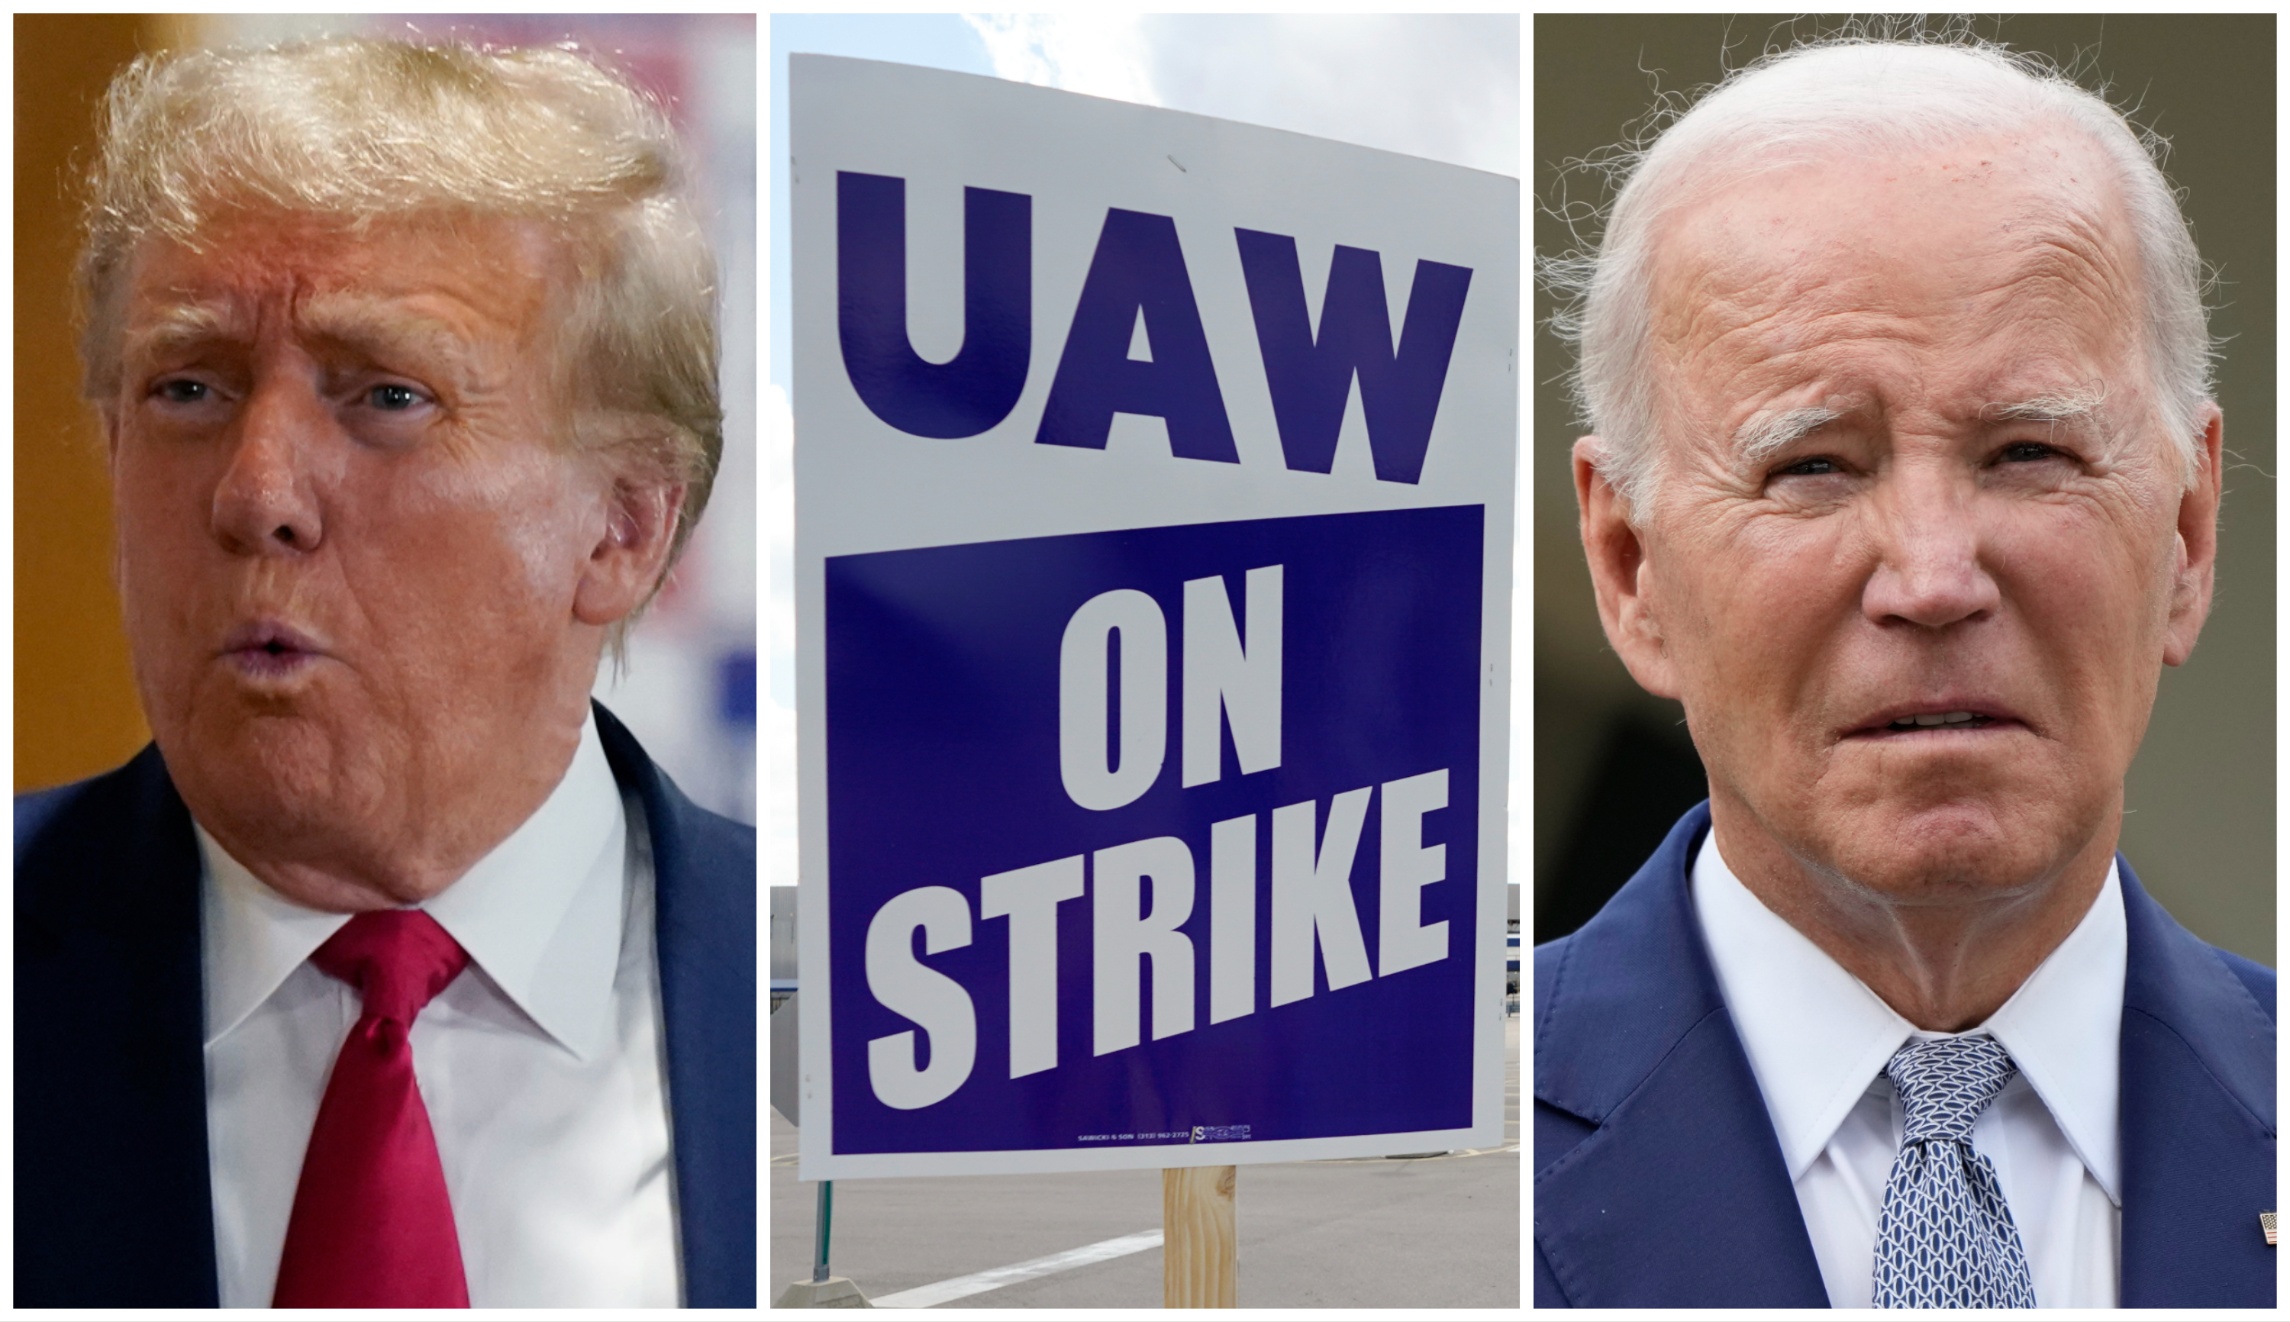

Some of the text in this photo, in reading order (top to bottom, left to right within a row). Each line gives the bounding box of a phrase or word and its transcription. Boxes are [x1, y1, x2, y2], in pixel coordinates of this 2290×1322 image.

[836, 170, 1474, 486] UAW
[1060, 564, 1284, 811] ON
[865, 768, 1449, 1110] STRIKE
